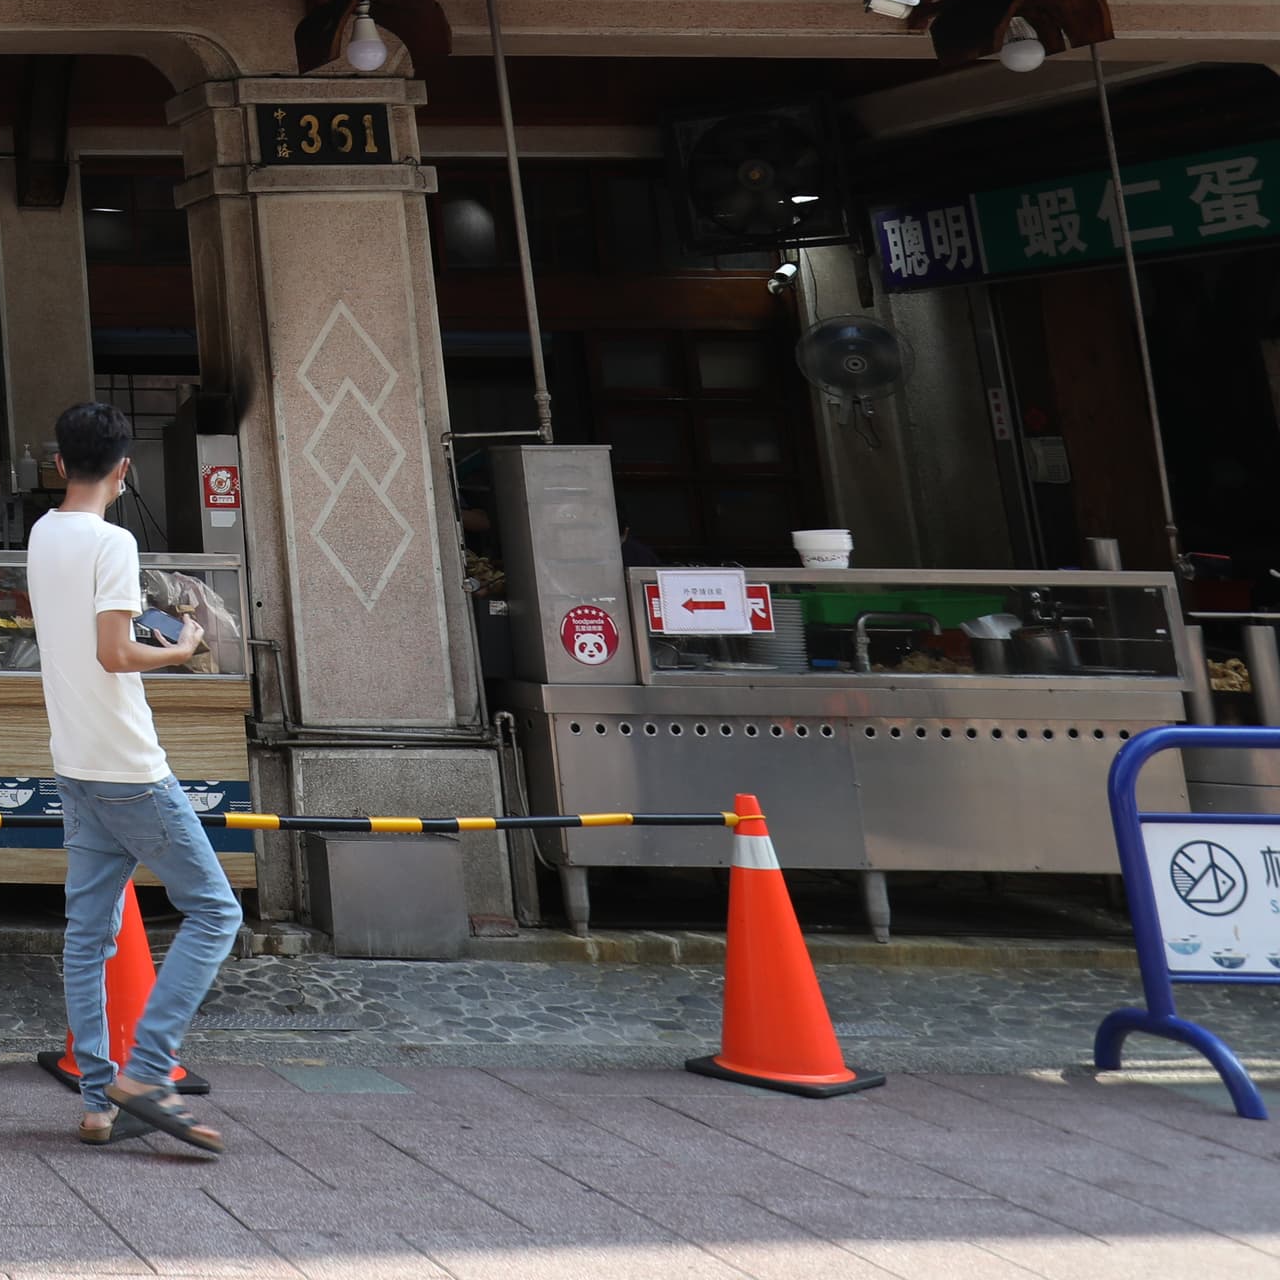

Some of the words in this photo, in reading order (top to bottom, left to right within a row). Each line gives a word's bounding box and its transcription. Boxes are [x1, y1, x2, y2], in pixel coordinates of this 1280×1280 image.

[883, 205, 975, 278] 聰明
[1017, 156, 1271, 258] 蝦仁蛋
